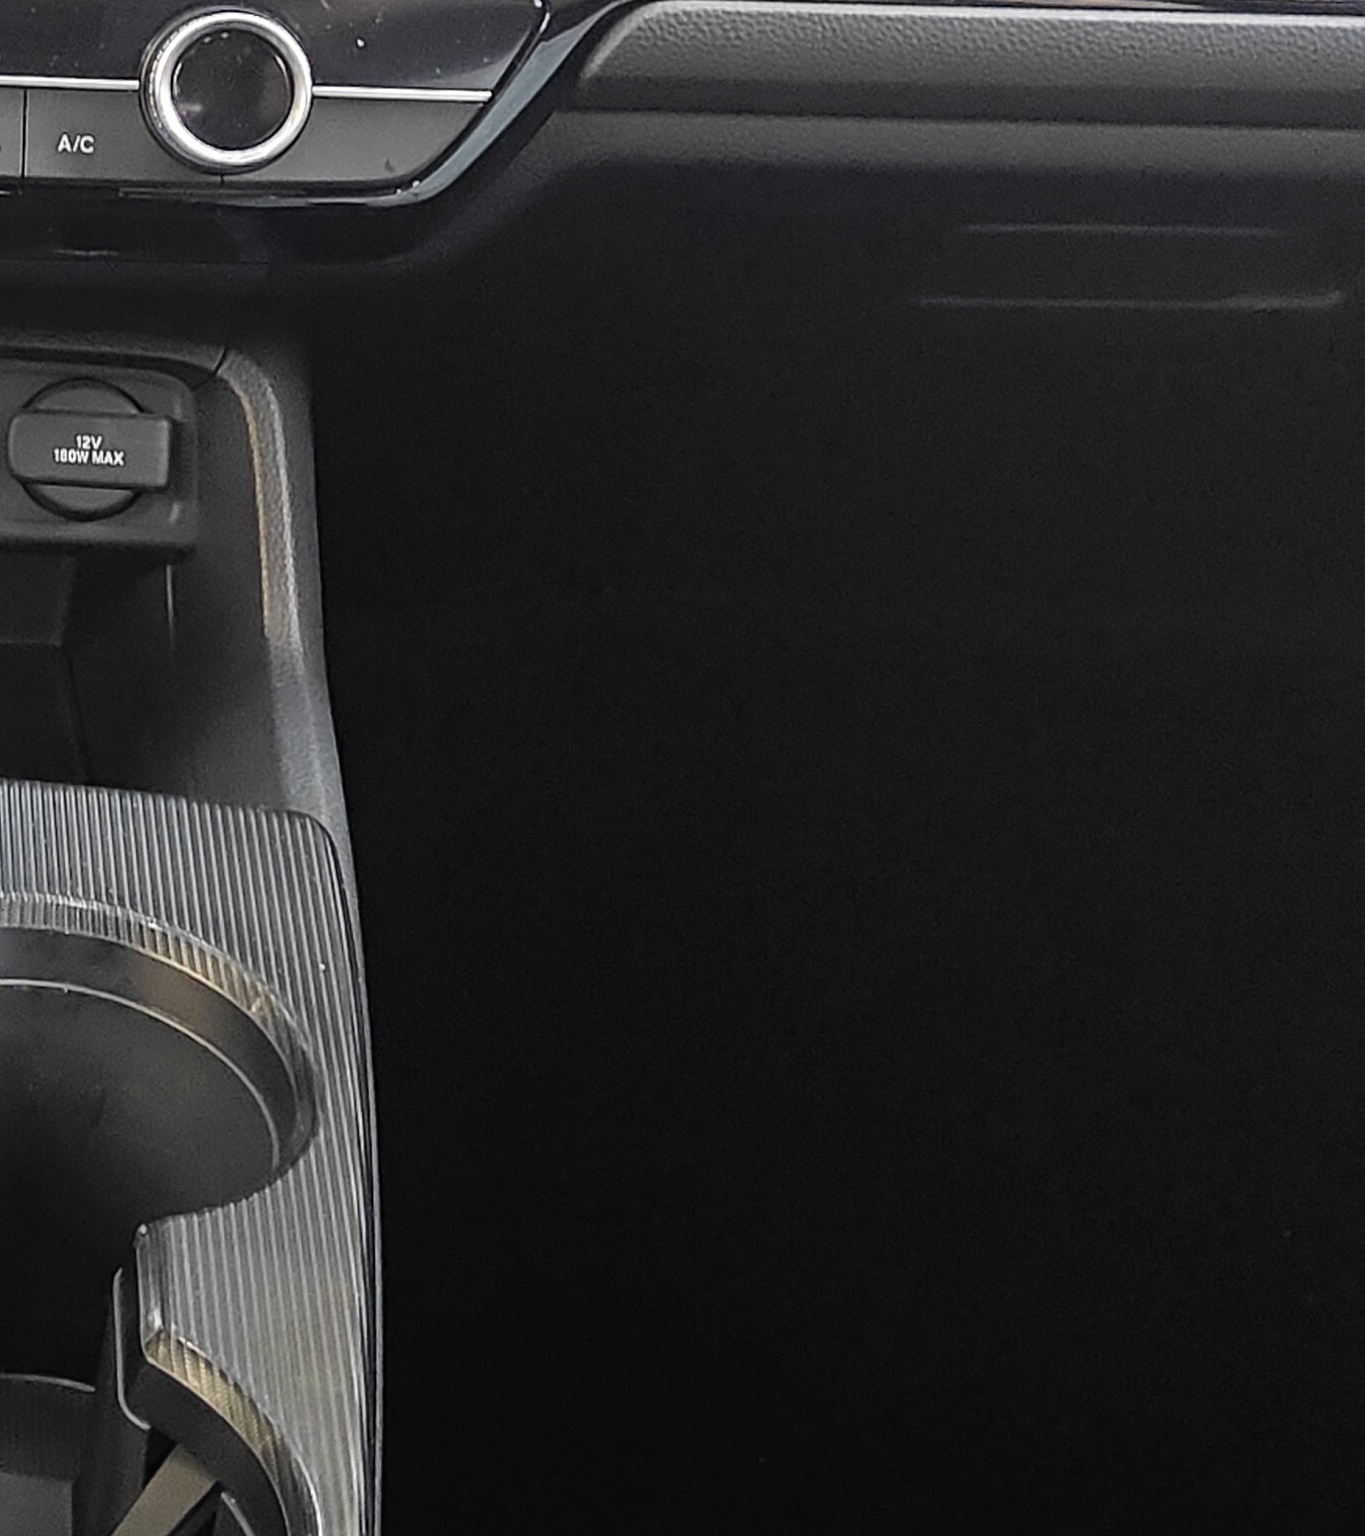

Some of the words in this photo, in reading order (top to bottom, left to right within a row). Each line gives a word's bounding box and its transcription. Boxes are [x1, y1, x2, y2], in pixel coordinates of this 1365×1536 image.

[57, 133, 95, 154] A/C
[76, 434, 102, 450] 12V
[92, 449, 125, 467] MAX
